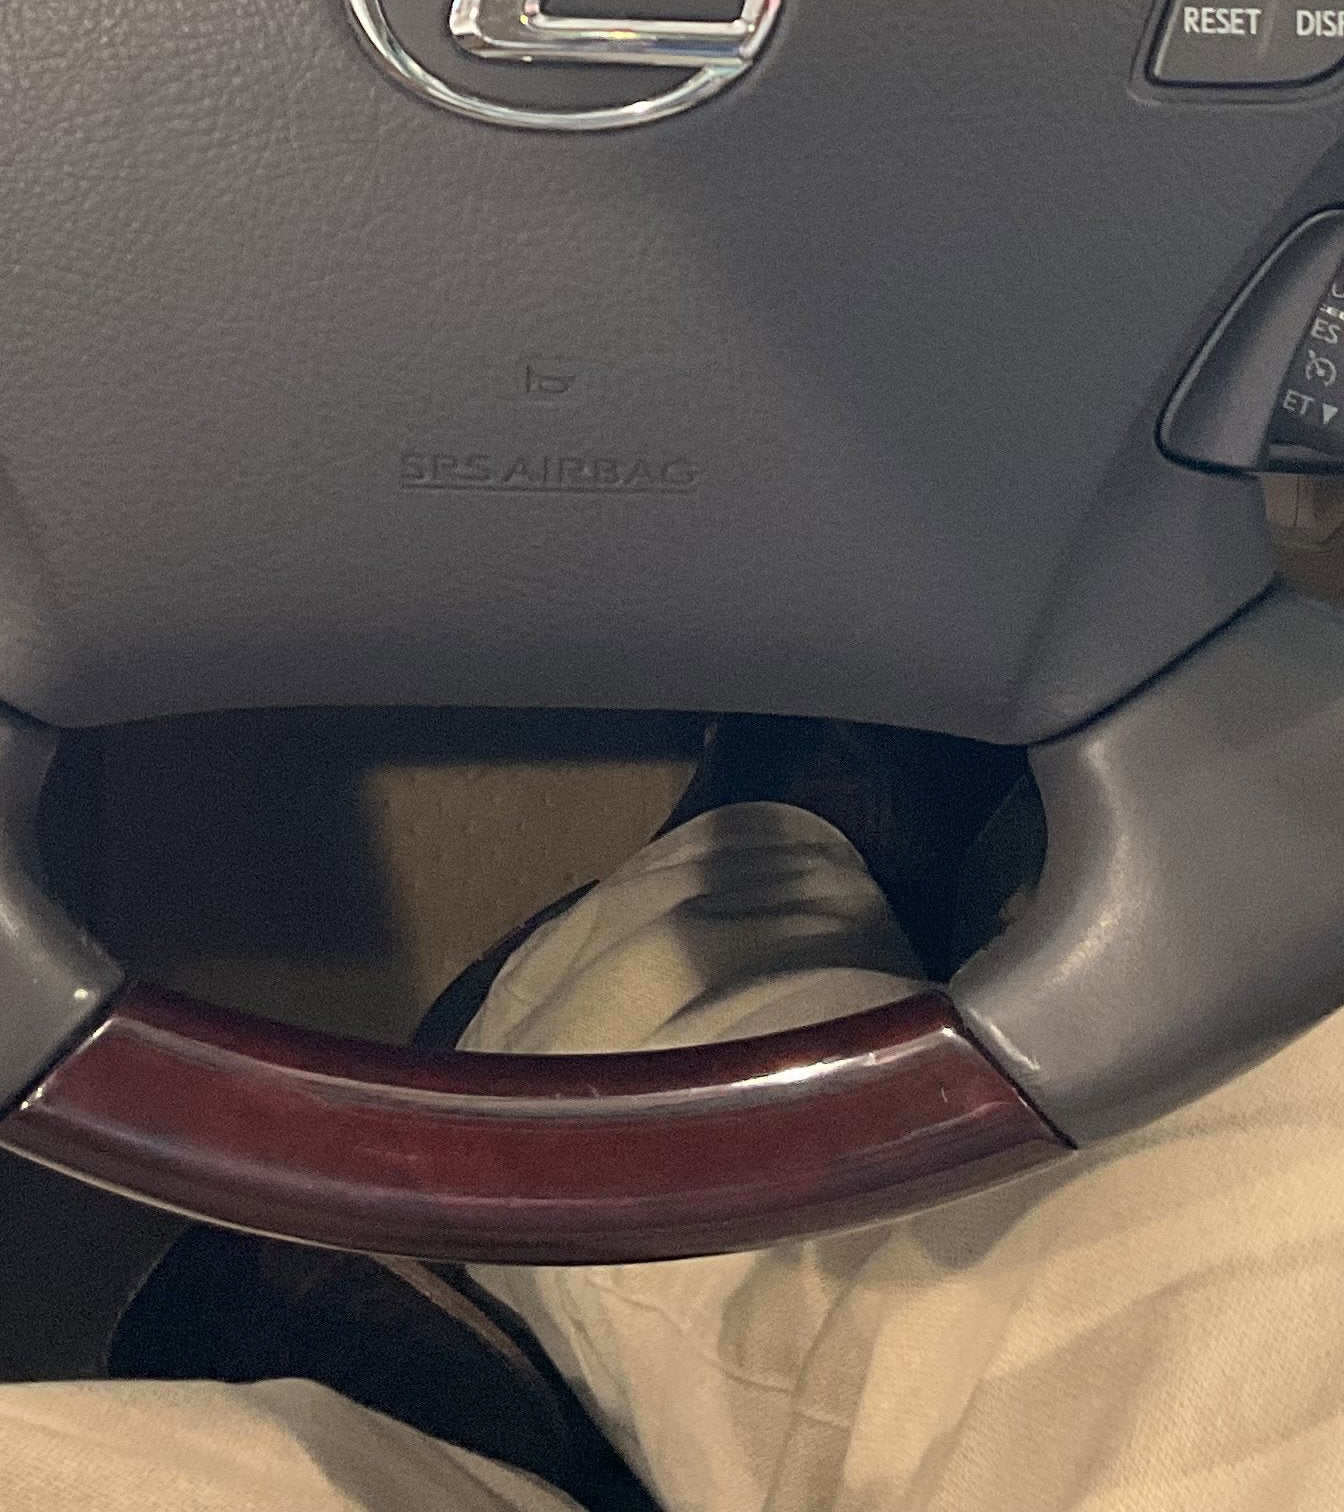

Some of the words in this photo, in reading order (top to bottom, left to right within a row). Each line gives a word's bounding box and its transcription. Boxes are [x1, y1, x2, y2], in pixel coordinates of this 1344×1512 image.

[1183, 6, 1262, 35] RESET
[1309, 318, 1342, 345] ES
[1282, 389, 1315, 416] ET
